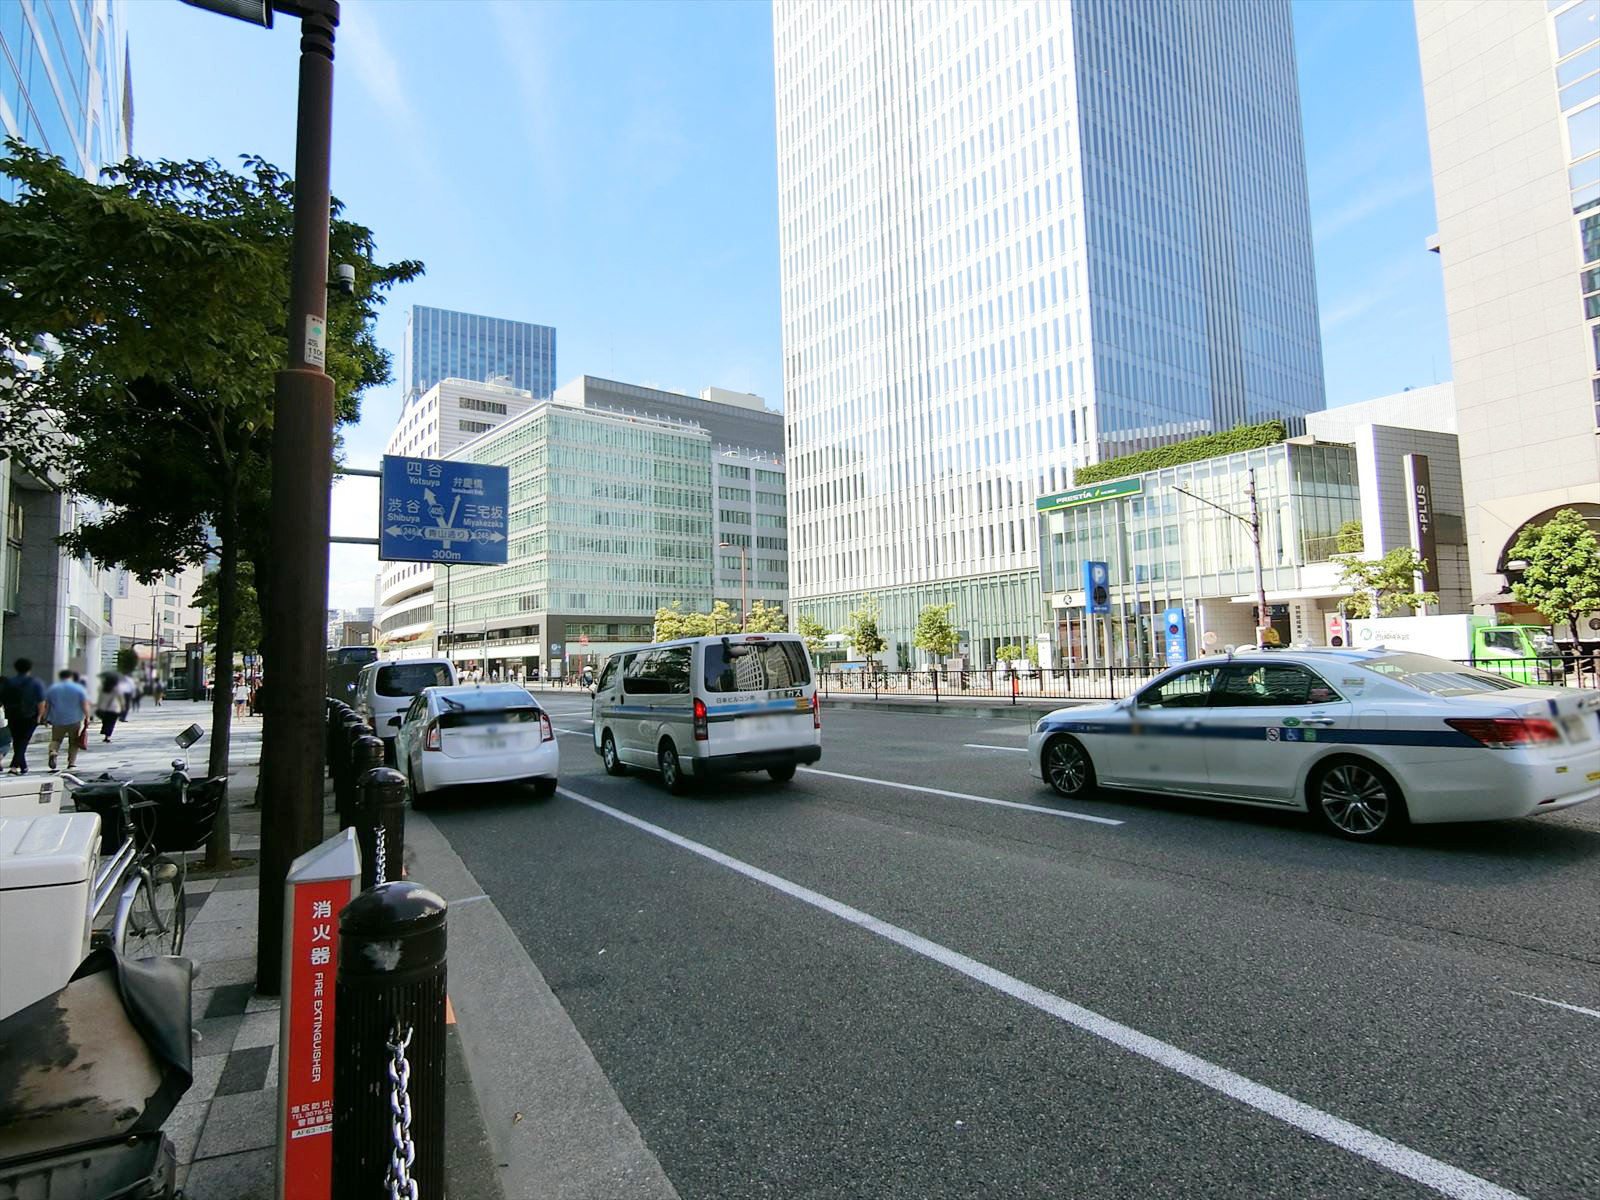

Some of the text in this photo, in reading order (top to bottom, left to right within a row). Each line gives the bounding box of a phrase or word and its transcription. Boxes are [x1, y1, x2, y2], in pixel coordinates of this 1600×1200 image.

[407, 461, 442, 477] 四谷
[409, 476, 440, 487] Yotsuya
[388, 498, 420, 513] 渋谷
[464, 504, 503, 519] 三宅坂
[387, 513, 420, 523] Shibuya
[464, 518, 504, 528] Miyakezaka
[401, 526, 417, 535] 246
[428, 529, 465, 538] 青山通り
[432, 549, 461, 560] 300m
[311, 900, 332, 966] 消火器
[312, 972, 324, 1083] FIRE EXTINGUISHER
[291, 1100, 333, 1114] 港区防災
